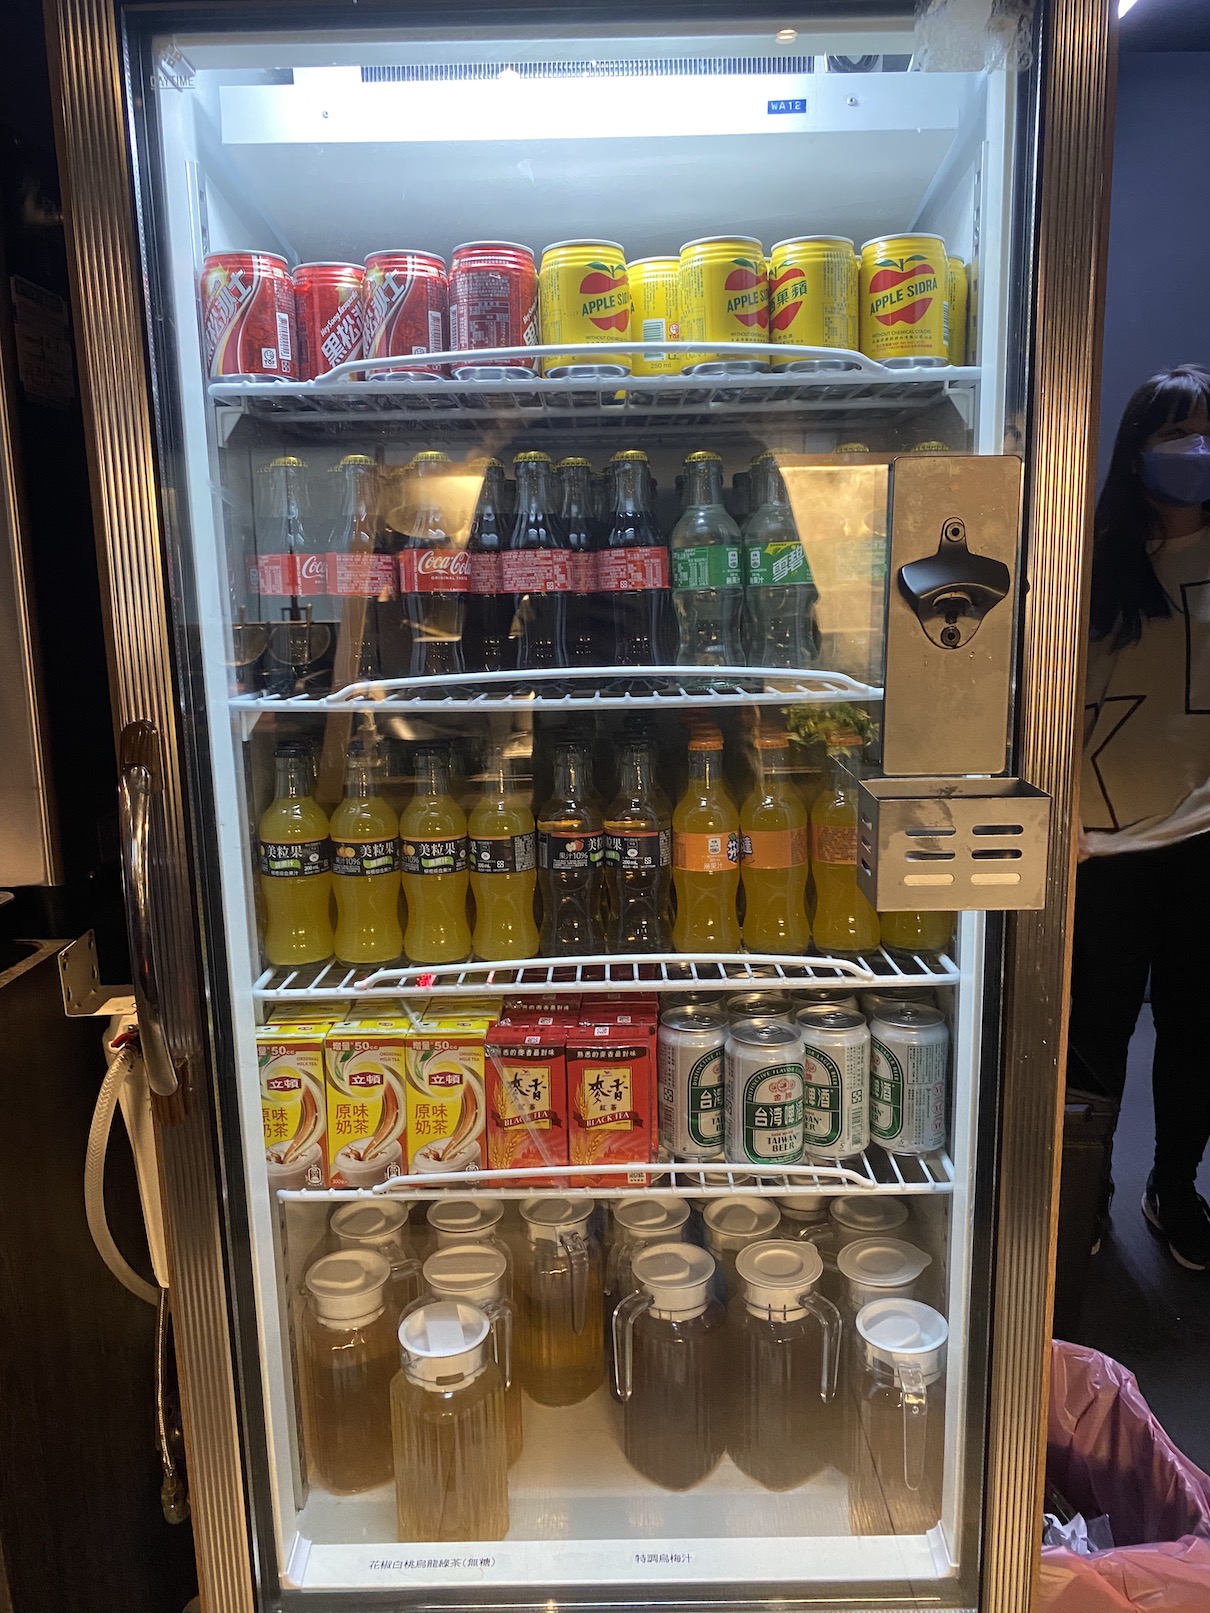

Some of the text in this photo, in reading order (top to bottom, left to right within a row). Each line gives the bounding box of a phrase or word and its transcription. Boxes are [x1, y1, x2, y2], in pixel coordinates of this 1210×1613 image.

[771, 101, 801, 110] WA12
[727, 292, 758, 313] APPLE
[870, 278, 938, 316] APPLE SIDRA
[582, 295, 616, 317] APPLE
[268, 844, 303, 858] 美粒果
[360, 842, 394, 858] 美粒果
[419, 842, 456, 857] 美粒果
[558, 852, 588, 860] 果汁10%
[332, 1041, 350, 1051] 增量
[412, 1041, 431, 1051] 增量
[270, 1078, 300, 1090] 立頓
[351, 1074, 382, 1085] 立頓
[430, 1074, 461, 1085] 立頓
[588, 1074, 629, 1105] 麥香
[336, 1103, 369, 1119] 原味
[415, 1103, 448, 1119] 原味
[600, 1104, 617, 1112] 紅茶
[586, 1112, 630, 1127] BLACK TEA
[336, 1120, 369, 1135] 奶茶
[415, 1120, 448, 1135] 奶茶
[767, 1134, 797, 1144] TAIWAN
[772, 1142, 794, 1152] BEER
[635, 1554, 692, 1563] 特調烏梅汁
